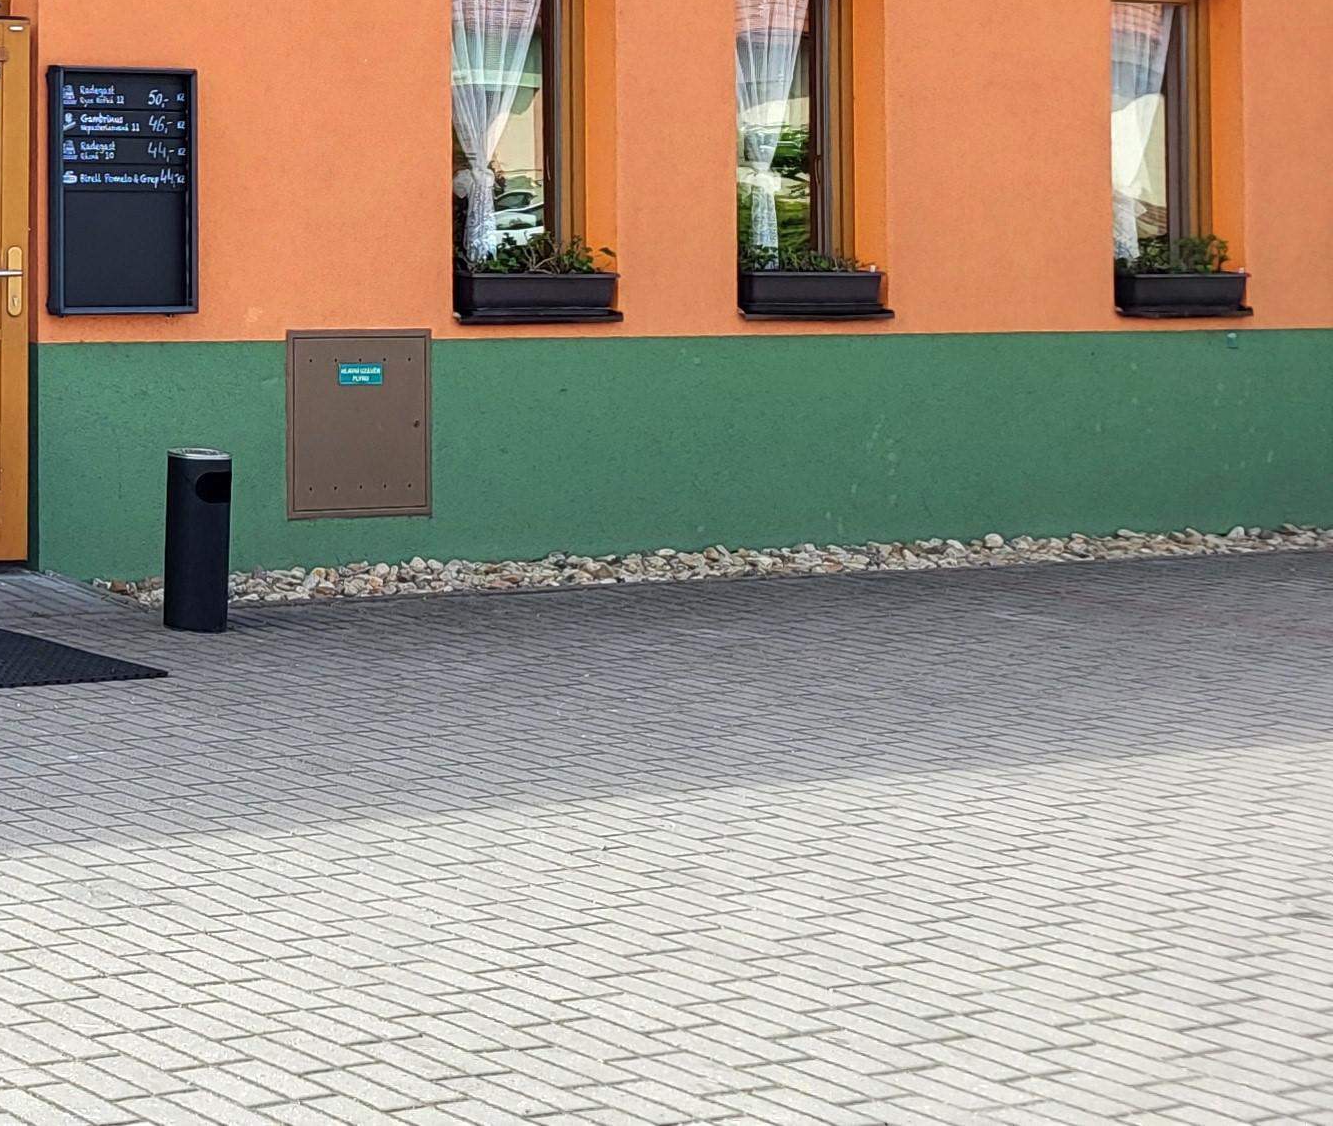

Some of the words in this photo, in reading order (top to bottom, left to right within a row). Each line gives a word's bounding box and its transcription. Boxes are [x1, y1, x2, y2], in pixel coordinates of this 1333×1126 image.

[79, 84, 116, 97] Radegast
[116, 95, 125, 105] 12
[80, 112, 124, 124] Gambrinus
[131, 122, 140, 132] 11
[80, 139, 116, 154] Radegast
[104, 151, 115, 161] 10
[104, 173, 133, 183] Pomelo
[139, 173, 160, 189] Grep
